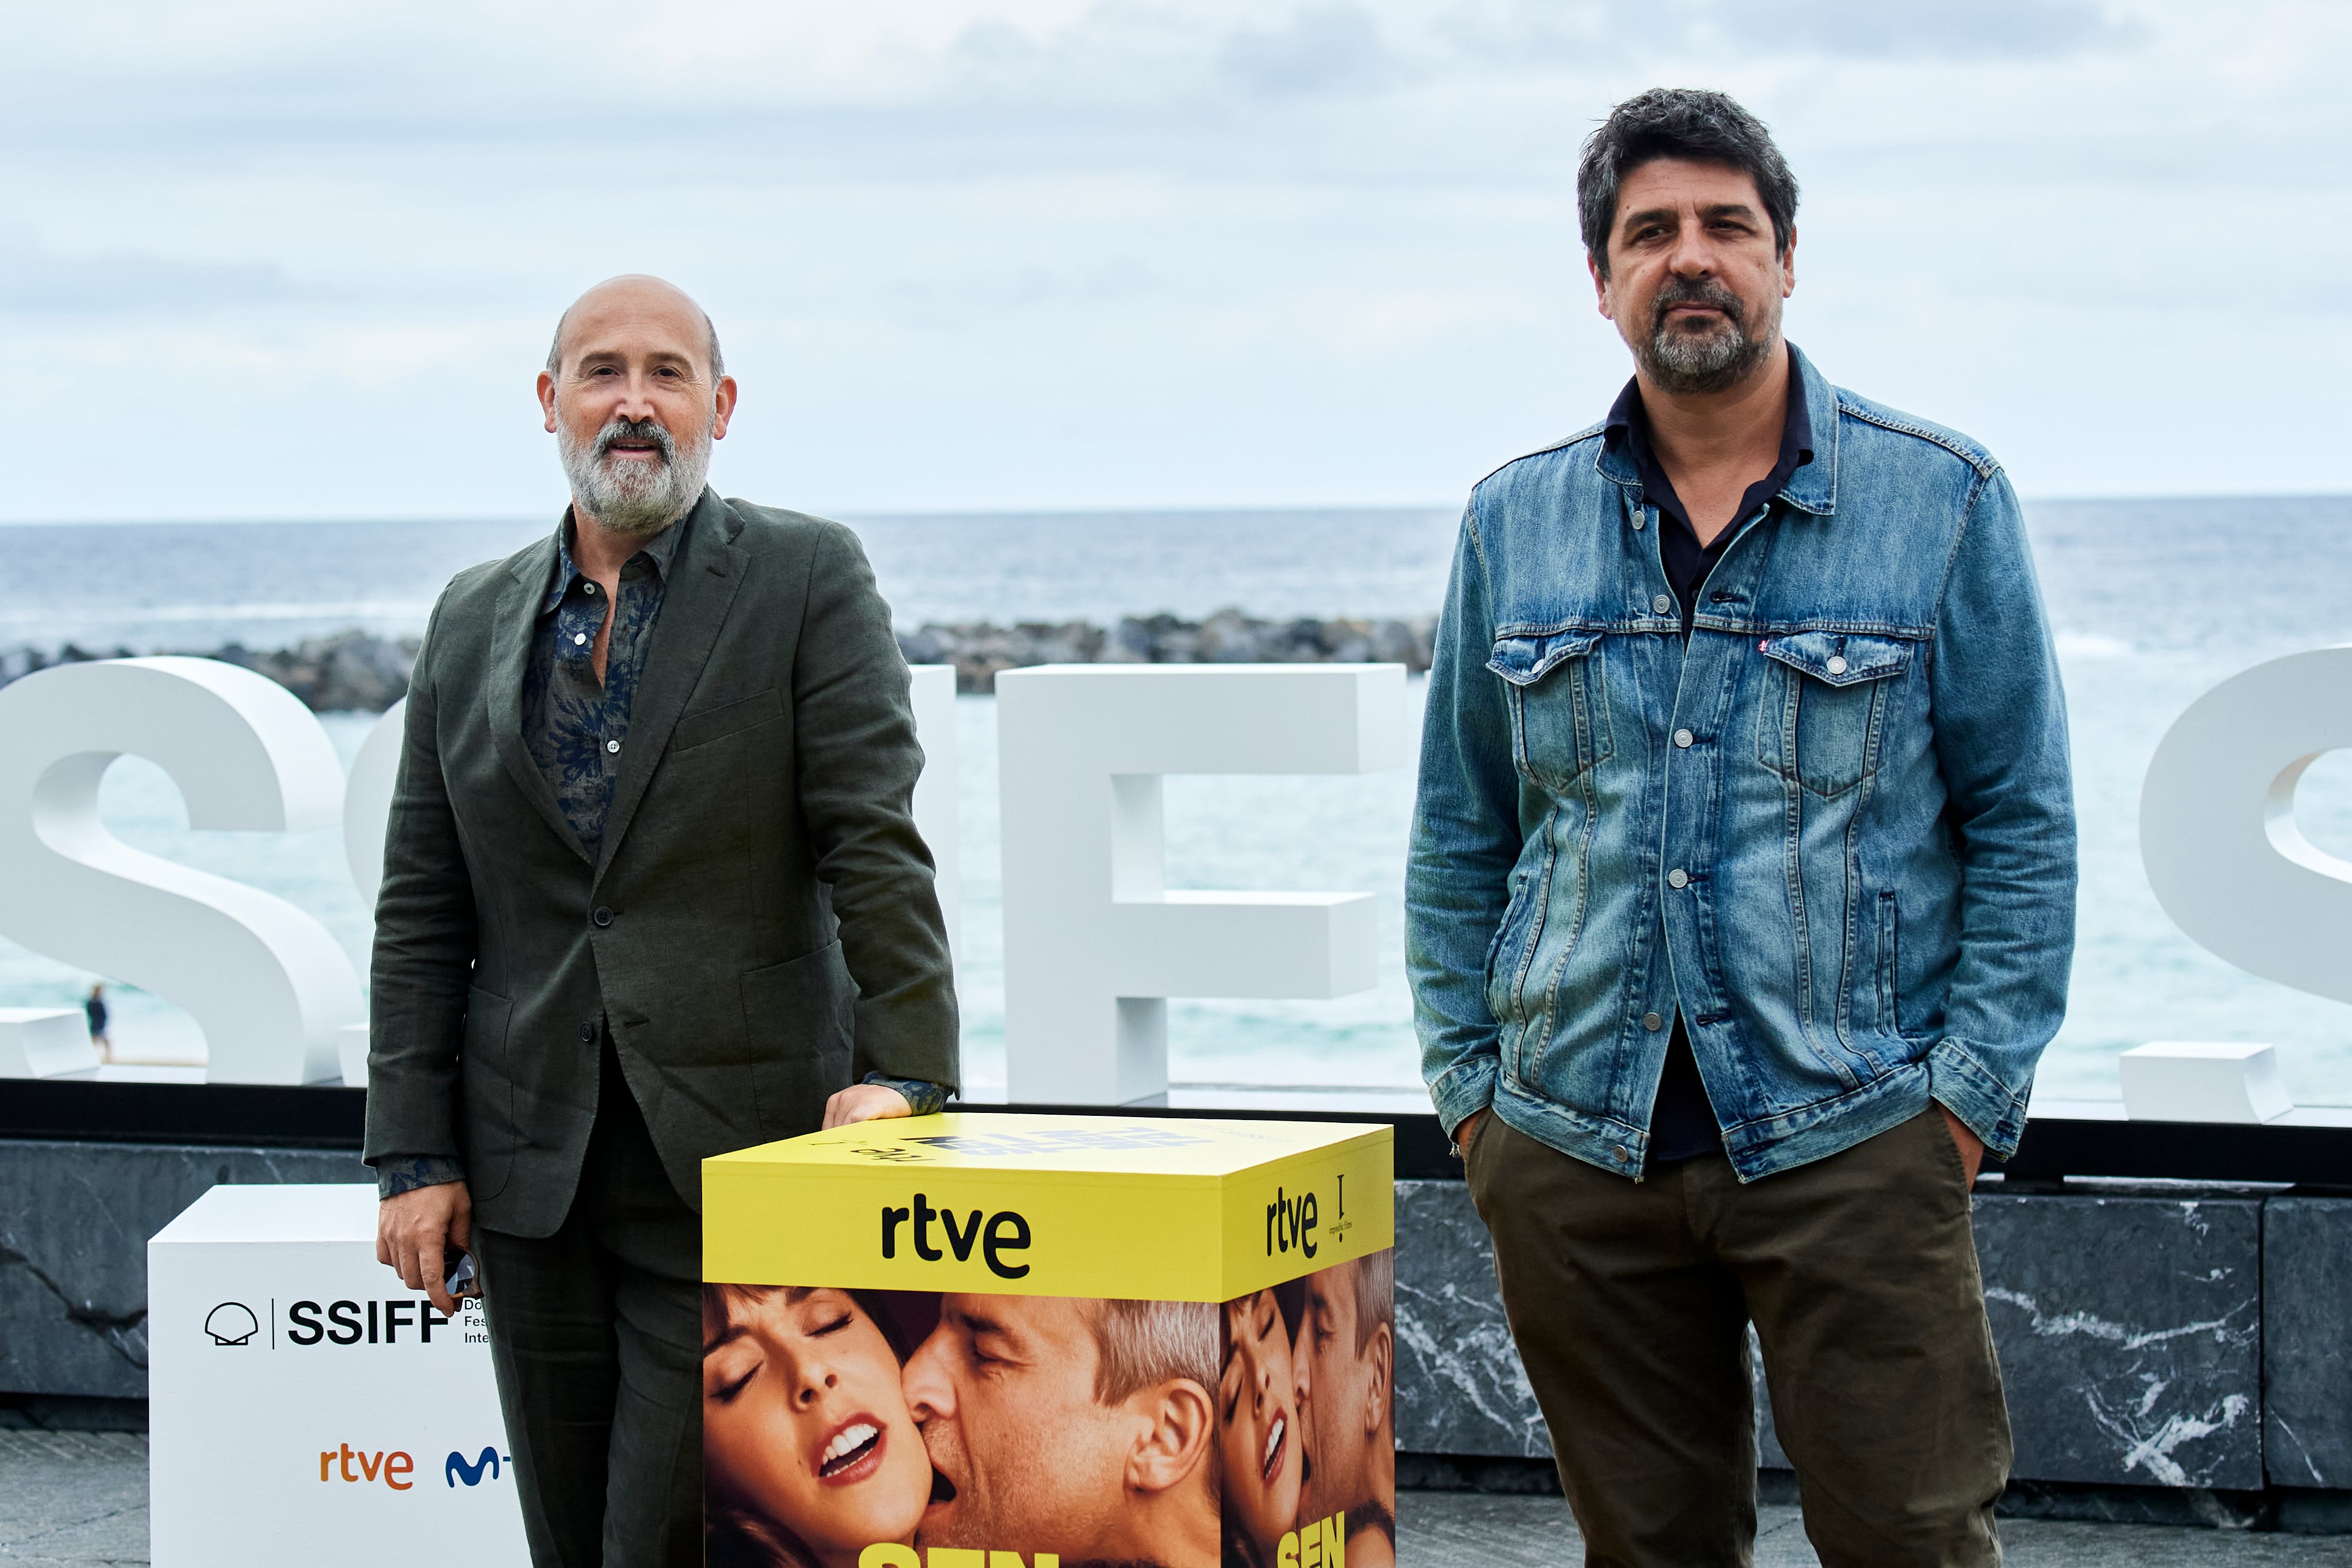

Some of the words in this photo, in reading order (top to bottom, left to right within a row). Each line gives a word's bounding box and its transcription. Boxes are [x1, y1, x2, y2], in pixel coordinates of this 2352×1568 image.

[882, 1193, 1031, 1279] rtve
[1267, 1186, 1317, 1259] rtve
[288, 1300, 448, 1345] SSIFF
[320, 1443, 413, 1490] rtve
[1277, 1510, 1345, 1568] SEN
